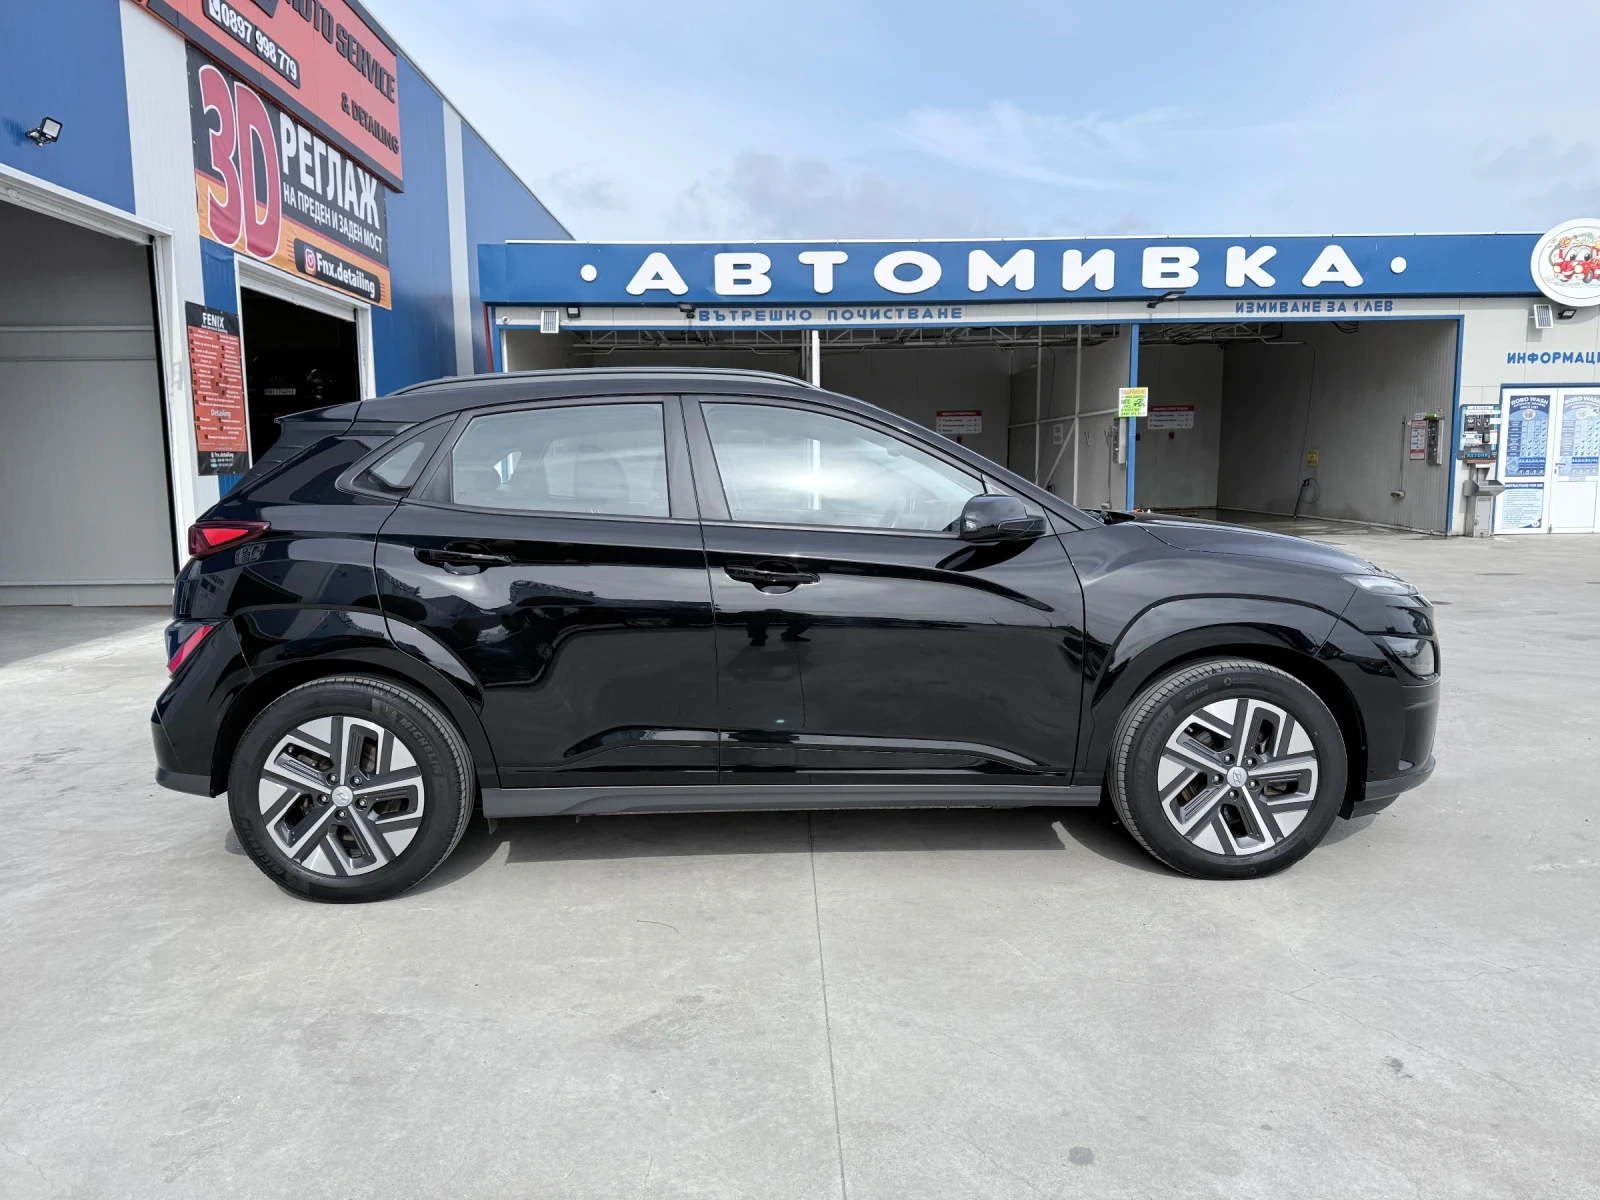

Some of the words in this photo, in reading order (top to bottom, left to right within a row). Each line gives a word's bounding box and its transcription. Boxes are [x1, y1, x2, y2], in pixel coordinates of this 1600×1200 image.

[221, 3, 252, 44] 0897
[255, 30, 277, 64] 998
[277, 48, 297, 81] 779
[336, 23, 396, 104] SERVICE
[341, 92, 350, 116] &
[351, 100, 399, 154] DETAILING
[198, 64, 282, 261] 3D
[279, 111, 380, 230] РЕГЛАЖ
[283, 181, 297, 208] НА
[297, 190, 331, 226] ПРЕДЕН
[331, 209, 339, 231] И
[339, 214, 363, 244] ЗАДЕН
[363, 228, 383, 254] МОСТ
[316, 252, 376, 299] Fnx.detailing
[626, 244, 1364, 296] АВТОМИВКА
[202, 312, 224, 329] FENIX
[698, 308, 813, 322] ВЪТРЕШНО
[827, 307, 963, 321] ПОЧИСТВАНЕ
[1235, 300, 1322, 314] ИЗМИВАНЕ
[1326, 300, 1347, 313] ЗА
[1352, 300, 1359, 312] 1
[1363, 299, 1394, 313] ЛЕВ
[1530, 396, 1549, 405] WASH
[399, 717, 443, 777] MICHELIN
